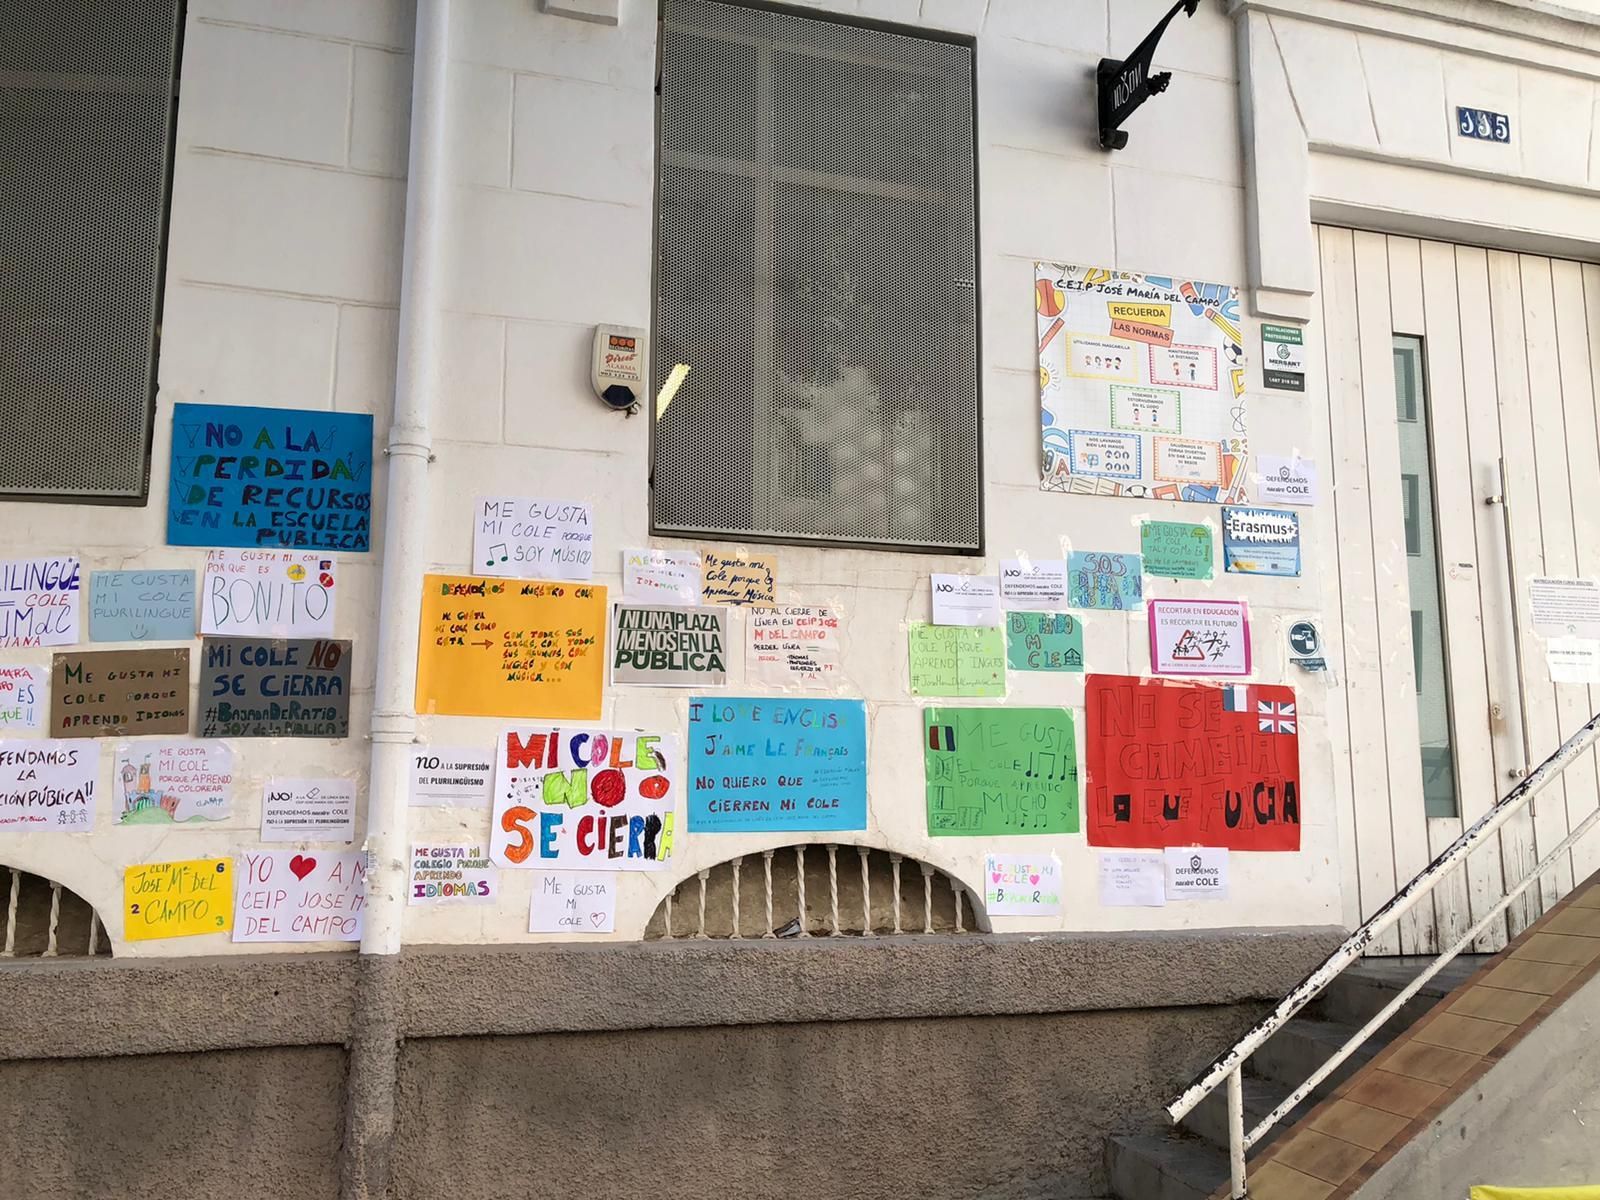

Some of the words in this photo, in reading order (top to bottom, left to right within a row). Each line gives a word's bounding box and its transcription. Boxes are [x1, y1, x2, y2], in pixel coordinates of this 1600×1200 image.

[1097, 284, 1122, 296] JOSÉ
[1127, 288, 1160, 300] MARÍA
[1164, 294, 1181, 303] DEL
[1185, 295, 1220, 307] CAMPO
[1114, 306, 1166, 318] RECUERDA
[1114, 322, 1130, 333] LAS
[1132, 325, 1170, 341] NORMAS
[205, 422, 243, 448] NO
[252, 426, 275, 449] A
[286, 426, 321, 452] LA
[188, 485, 224, 507] DE
[1287, 486, 1308, 494] COLE
[232, 511, 257, 528] LA
[484, 501, 514, 518] ME
[529, 503, 588, 525] GUSTA
[483, 521, 502, 535] MI
[512, 523, 556, 539] COLE
[1233, 519, 1294, 535] Erasmus+
[241, 551, 275, 561] GUSTA
[283, 553, 293, 562] MI
[513, 546, 545, 562] SOY
[705, 554, 718, 567] Me
[720, 559, 745, 570] gusta
[258, 566, 269, 574] ES
[1081, 553, 1128, 577] SOS
[96, 575, 124, 587] ME
[131, 574, 190, 586] GUSTA
[706, 570, 727, 581] Cole
[728, 576, 760, 588] porque
[25, 594, 69, 607] COLE
[95, 593, 118, 604] MI
[138, 591, 193, 602] COLE
[212, 576, 328, 630] BONITO
[94, 607, 192, 619] PLURILINGUE
[752, 607, 765, 615] NO
[1203, 608, 1239, 616] EDUCACIÓN
[474, 623, 496, 631] COMO
[623, 610, 640, 629] NI
[642, 611, 673, 629] UNA
[675, 613, 721, 632] PLAZA
[504, 631, 524, 639] CON
[619, 630, 677, 651] MENOS
[680, 633, 699, 652] EN
[702, 634, 722, 653] LA
[769, 630, 788, 639] DEL
[791, 630, 826, 640] CAMPO
[240, 647, 298, 666] COLE
[308, 641, 342, 669] NO
[912, 642, 938, 654] COLE
[107, 670, 153, 679] GUSTA
[162, 669, 181, 678] MI
[212, 674, 246, 697] SE
[18, 684, 34, 704] ES
[64, 694, 105, 705] COLE
[127, 690, 176, 701] PORQUE
[690, 703, 704, 722] I
[712, 703, 763, 722] LOVE
[1100, 684, 1156, 737] NO
[1178, 689, 1224, 733] SE
[62, 715, 128, 728] APRENDO
[136, 710, 185, 722] IDIOMAS
[956, 714, 1008, 750] ME
[1020, 722, 1073, 752] GUSTA
[178, 748, 206, 756] GUSTA
[569, 733, 662, 771] COLE
[765, 738, 786, 756] LE
[159, 761, 175, 772] MI
[178, 760, 209, 772] COLE
[416, 756, 440, 769] no
[455, 763, 489, 771] SUPRESIÓN
[957, 759, 980, 774] EL
[989, 759, 1022, 771] COLE
[17, 769, 36, 781] LA
[191, 775, 232, 784] APRENDO
[431, 776, 484, 785] PLURILINGÜISMO
[695, 776, 715, 790] NO
[778, 776, 803, 787] QUE
[167, 785, 175, 793] A
[178, 785, 223, 793] COLOREAR
[542, 767, 627, 809] NO
[807, 797, 840, 809] COLE
[983, 791, 1047, 815] MUCHO
[1096, 786, 1131, 828] LO
[501, 806, 564, 864] SE
[415, 848, 429, 856] ME
[431, 848, 464, 858] GUSTA
[216, 863, 225, 873] 6
[246, 854, 274, 885] YO
[328, 861, 342, 883] A
[414, 871, 462, 880] APRENDO
[192, 873, 217, 891] DEL
[543, 877, 562, 895] ME
[573, 884, 606, 896] GUSTA
[1195, 878, 1219, 886] COLE
[242, 889, 288, 911] CEIP
[566, 899, 577, 910] MI
[131, 904, 140, 914] 2
[145, 900, 209, 925] CAMPO
[216, 916, 224, 926] 3
[245, 917, 280, 936] DEL
[292, 915, 356, 935] CAMPO
[558, 917, 582, 926] COLE
